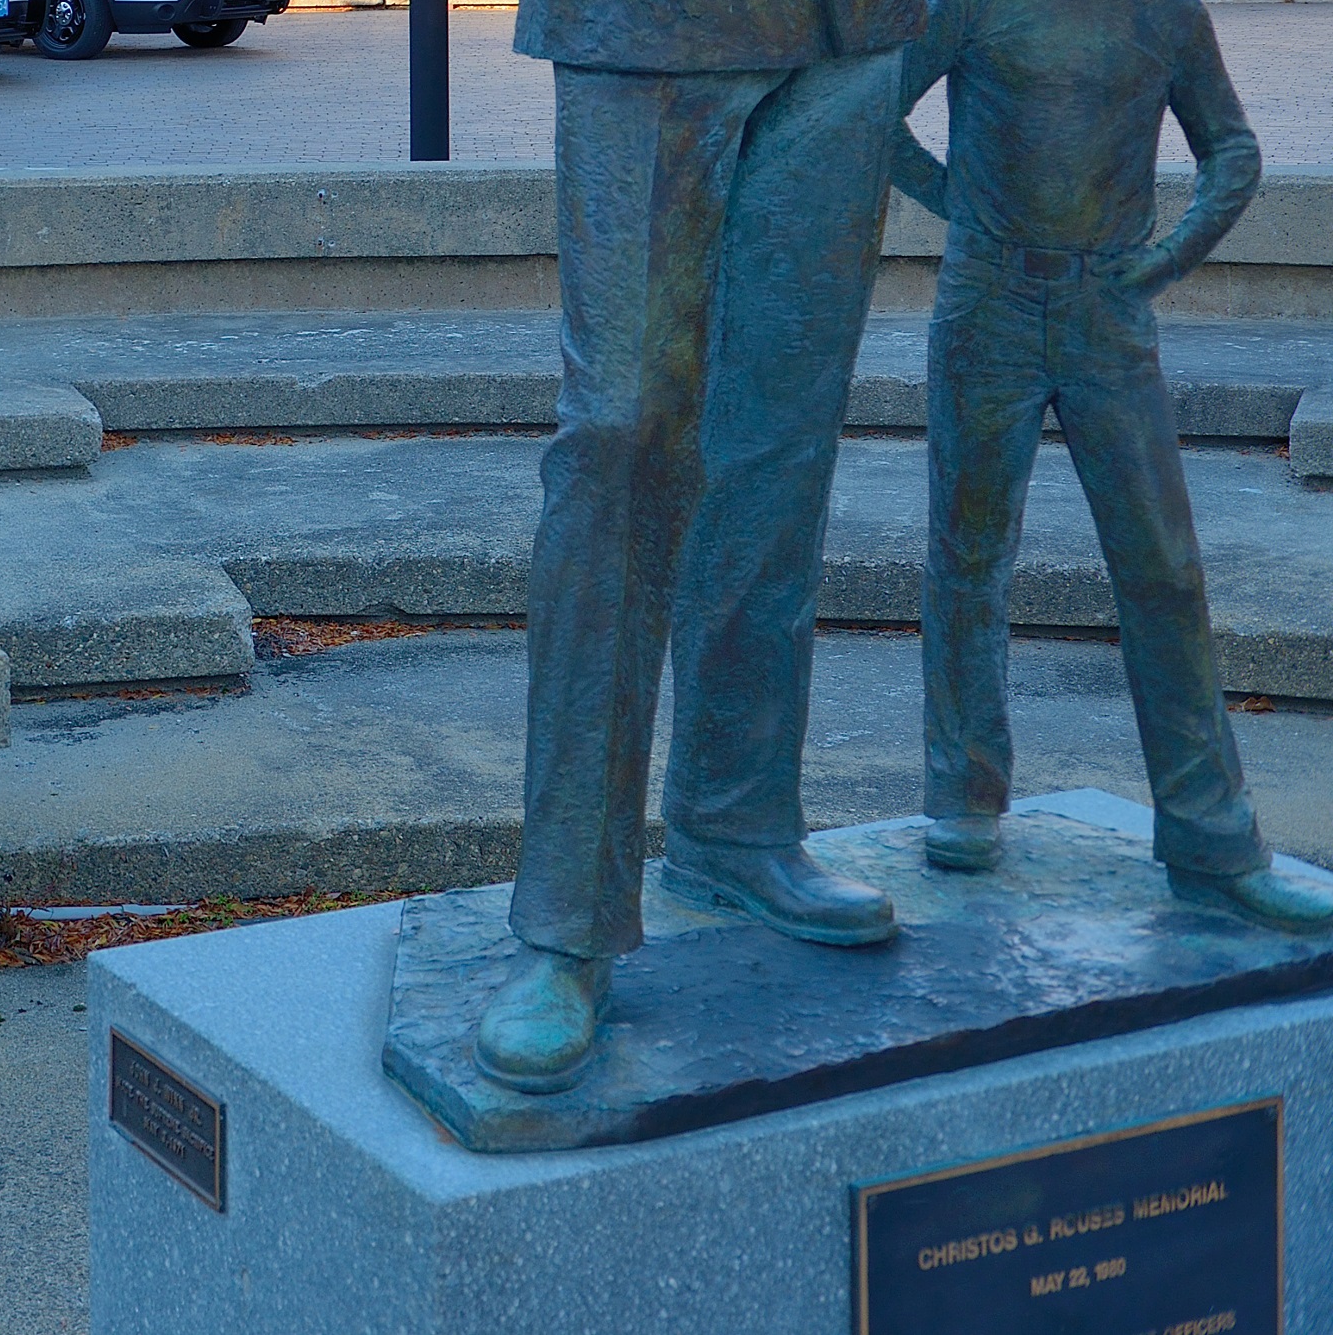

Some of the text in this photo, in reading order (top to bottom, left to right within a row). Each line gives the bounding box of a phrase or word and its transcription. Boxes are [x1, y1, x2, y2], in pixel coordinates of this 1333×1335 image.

[918, 1228, 1017, 1271] CHRISTOS
[1022, 1225, 1044, 1246] G.
[1133, 1179, 1229, 1220] MEMORIAL
[1030, 1270, 1066, 1298] MAY
[1068, 1265, 1091, 1290] 22,
